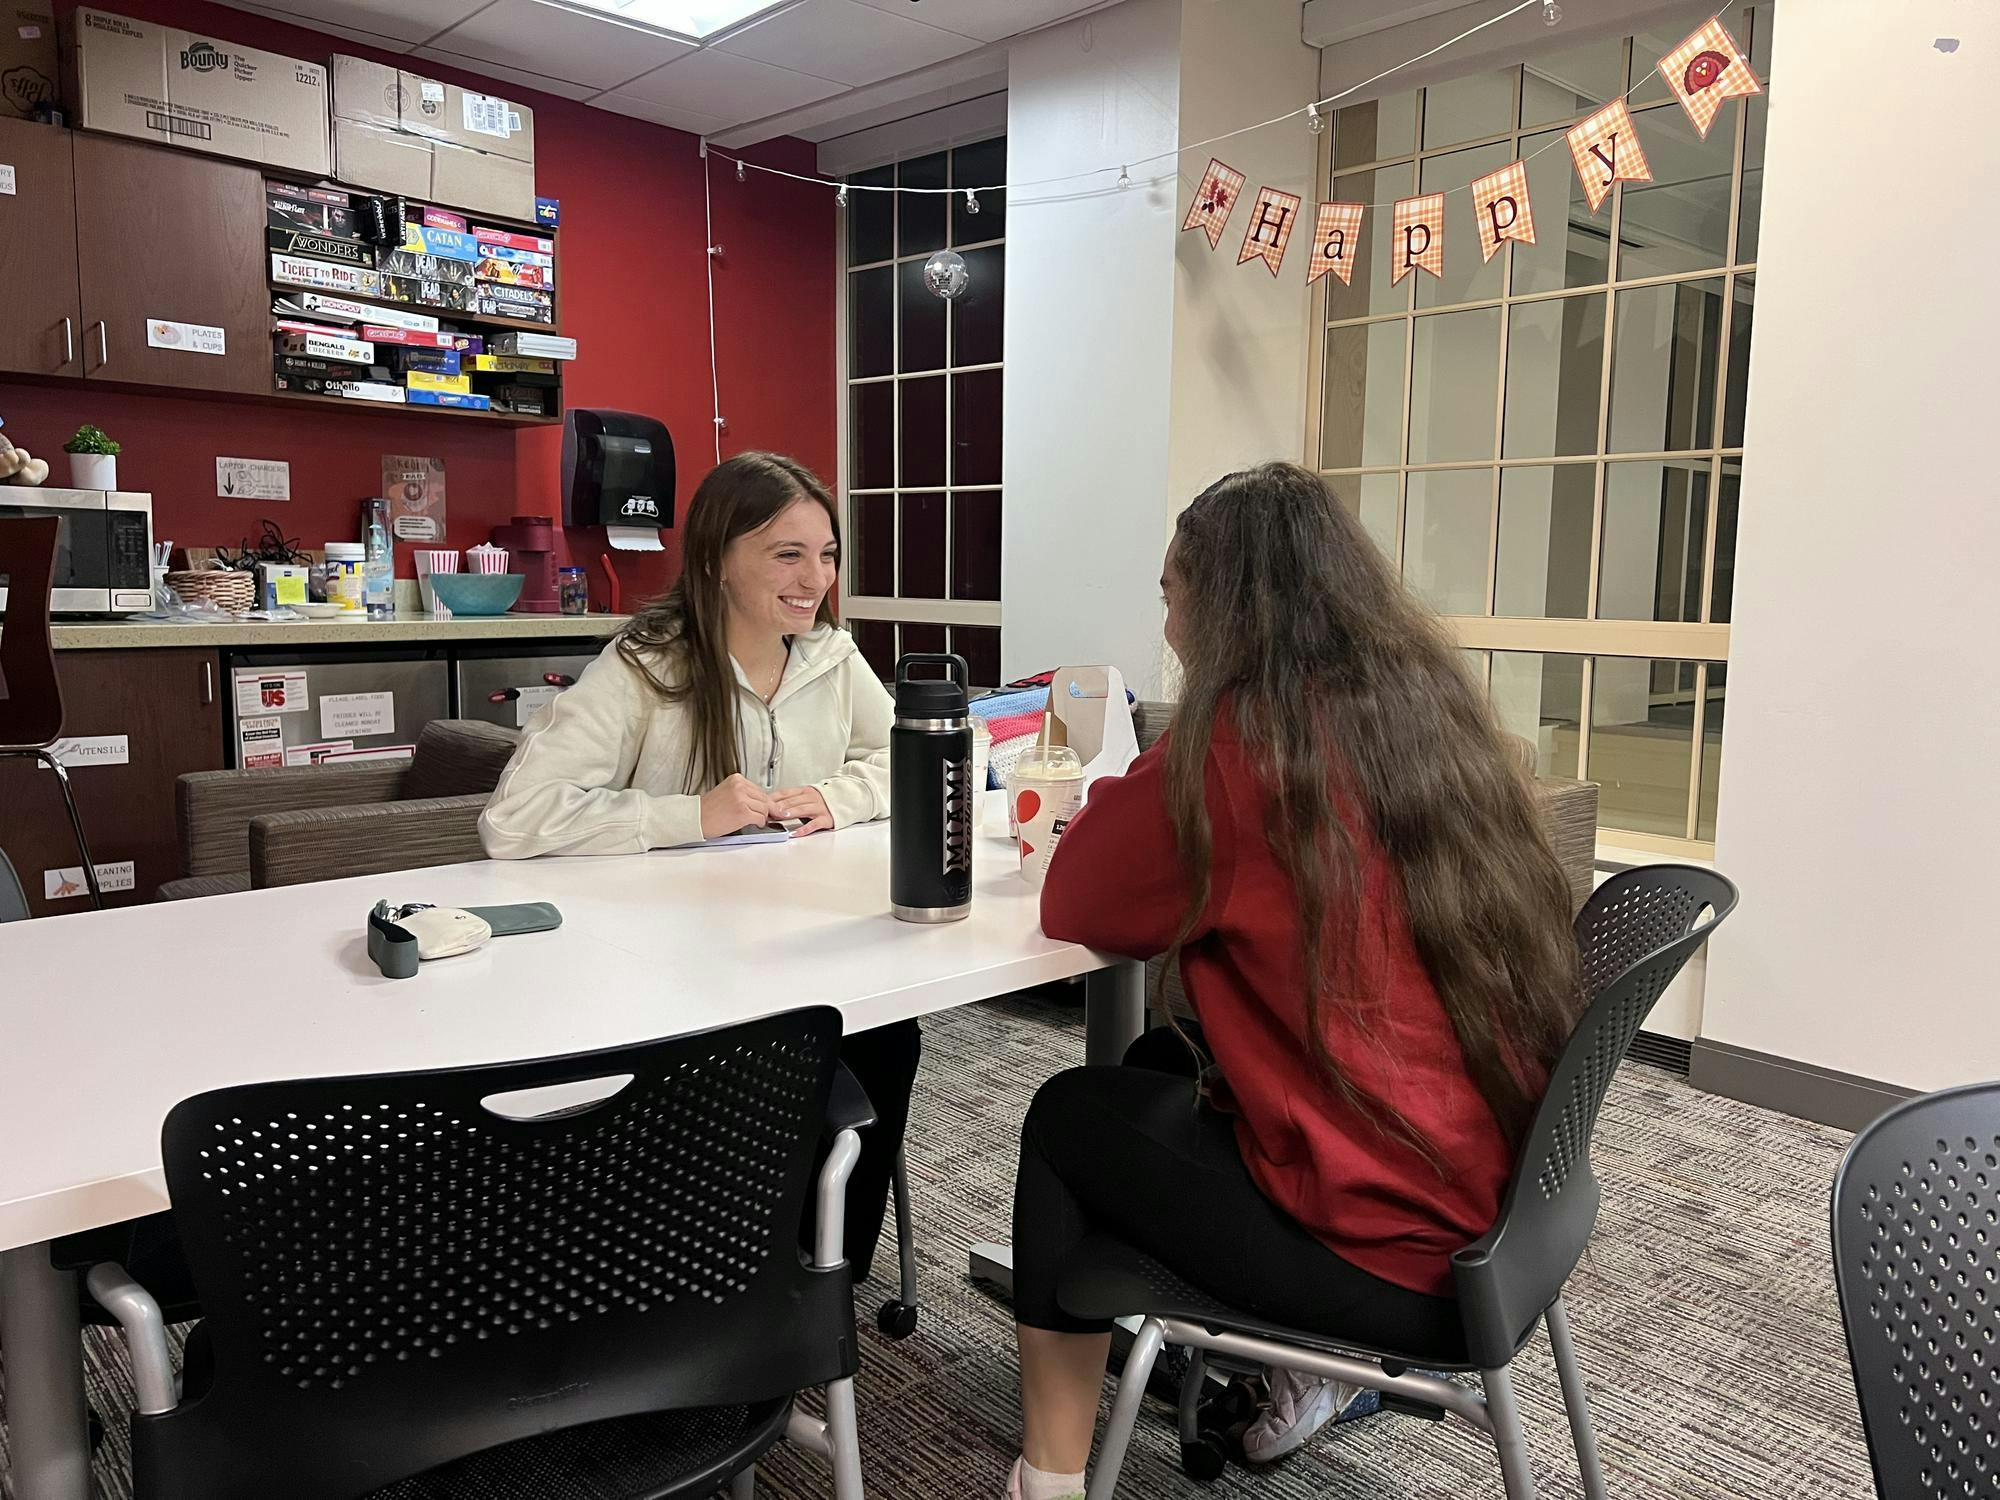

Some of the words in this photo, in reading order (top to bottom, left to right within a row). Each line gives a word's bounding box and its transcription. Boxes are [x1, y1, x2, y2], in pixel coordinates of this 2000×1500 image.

[84, 13, 93, 28] 8
[180, 50, 229, 70] Bounty
[233, 54, 246, 62] The
[233, 61, 258, 71] Quicker
[233, 67, 254, 77] Picker
[234, 73, 254, 83] Upper
[295, 72, 317, 87] 12212
[285, 229, 300, 253] 7
[296, 236, 359, 258] WONDERS
[426, 230, 462, 248] CATAN
[415, 254, 437, 270] DEAD
[280, 260, 319, 279] TICKET
[320, 269, 332, 279] TO
[332, 267, 356, 284] RIDE
[421, 280, 440, 297] DEAD
[493, 286, 533, 302] CITADELS
[321, 300, 361, 314] MONOPOLY
[192, 328, 222, 339] PLATES
[192, 341, 198, 349] &
[202, 342, 223, 352] CUPS
[308, 339, 345, 351] BENGALS
[308, 346, 344, 357] CHECKERS
[325, 380, 360, 392] Othello
[249, 464, 287, 473] CHARGERS
[261, 689, 286, 708] US
[79, 745, 126, 756] UTENSILS
[946, 764, 964, 867] MIAMI
[97, 865, 132, 876] EANING
